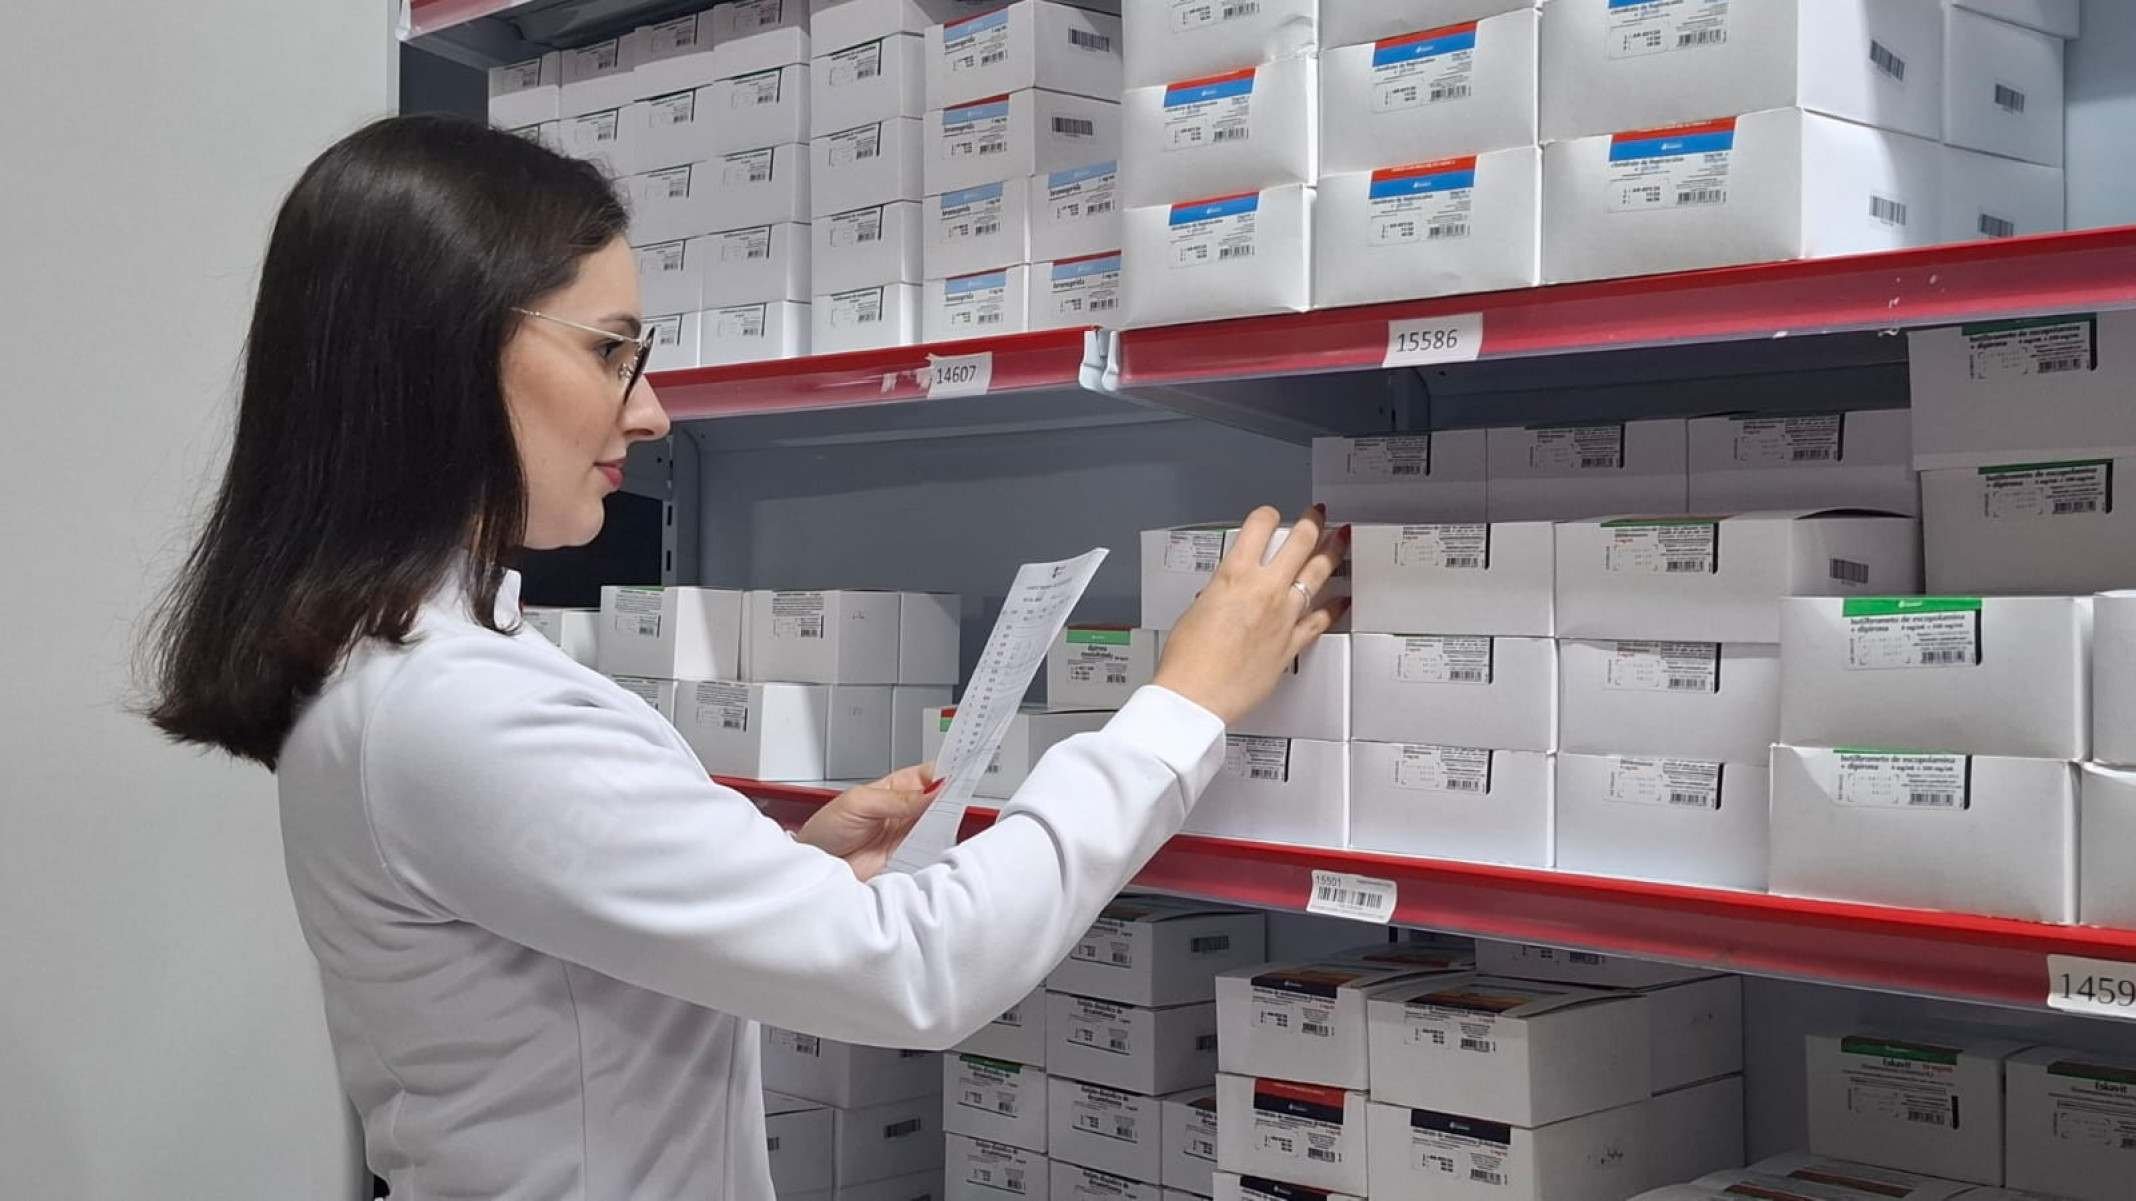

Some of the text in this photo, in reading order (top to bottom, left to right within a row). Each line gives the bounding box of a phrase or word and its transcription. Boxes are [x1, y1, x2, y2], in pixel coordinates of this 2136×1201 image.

[1396, 329, 1458, 352] 15586
[936, 365, 976, 384] 14607
[2060, 973, 2136, 1007] 1459
